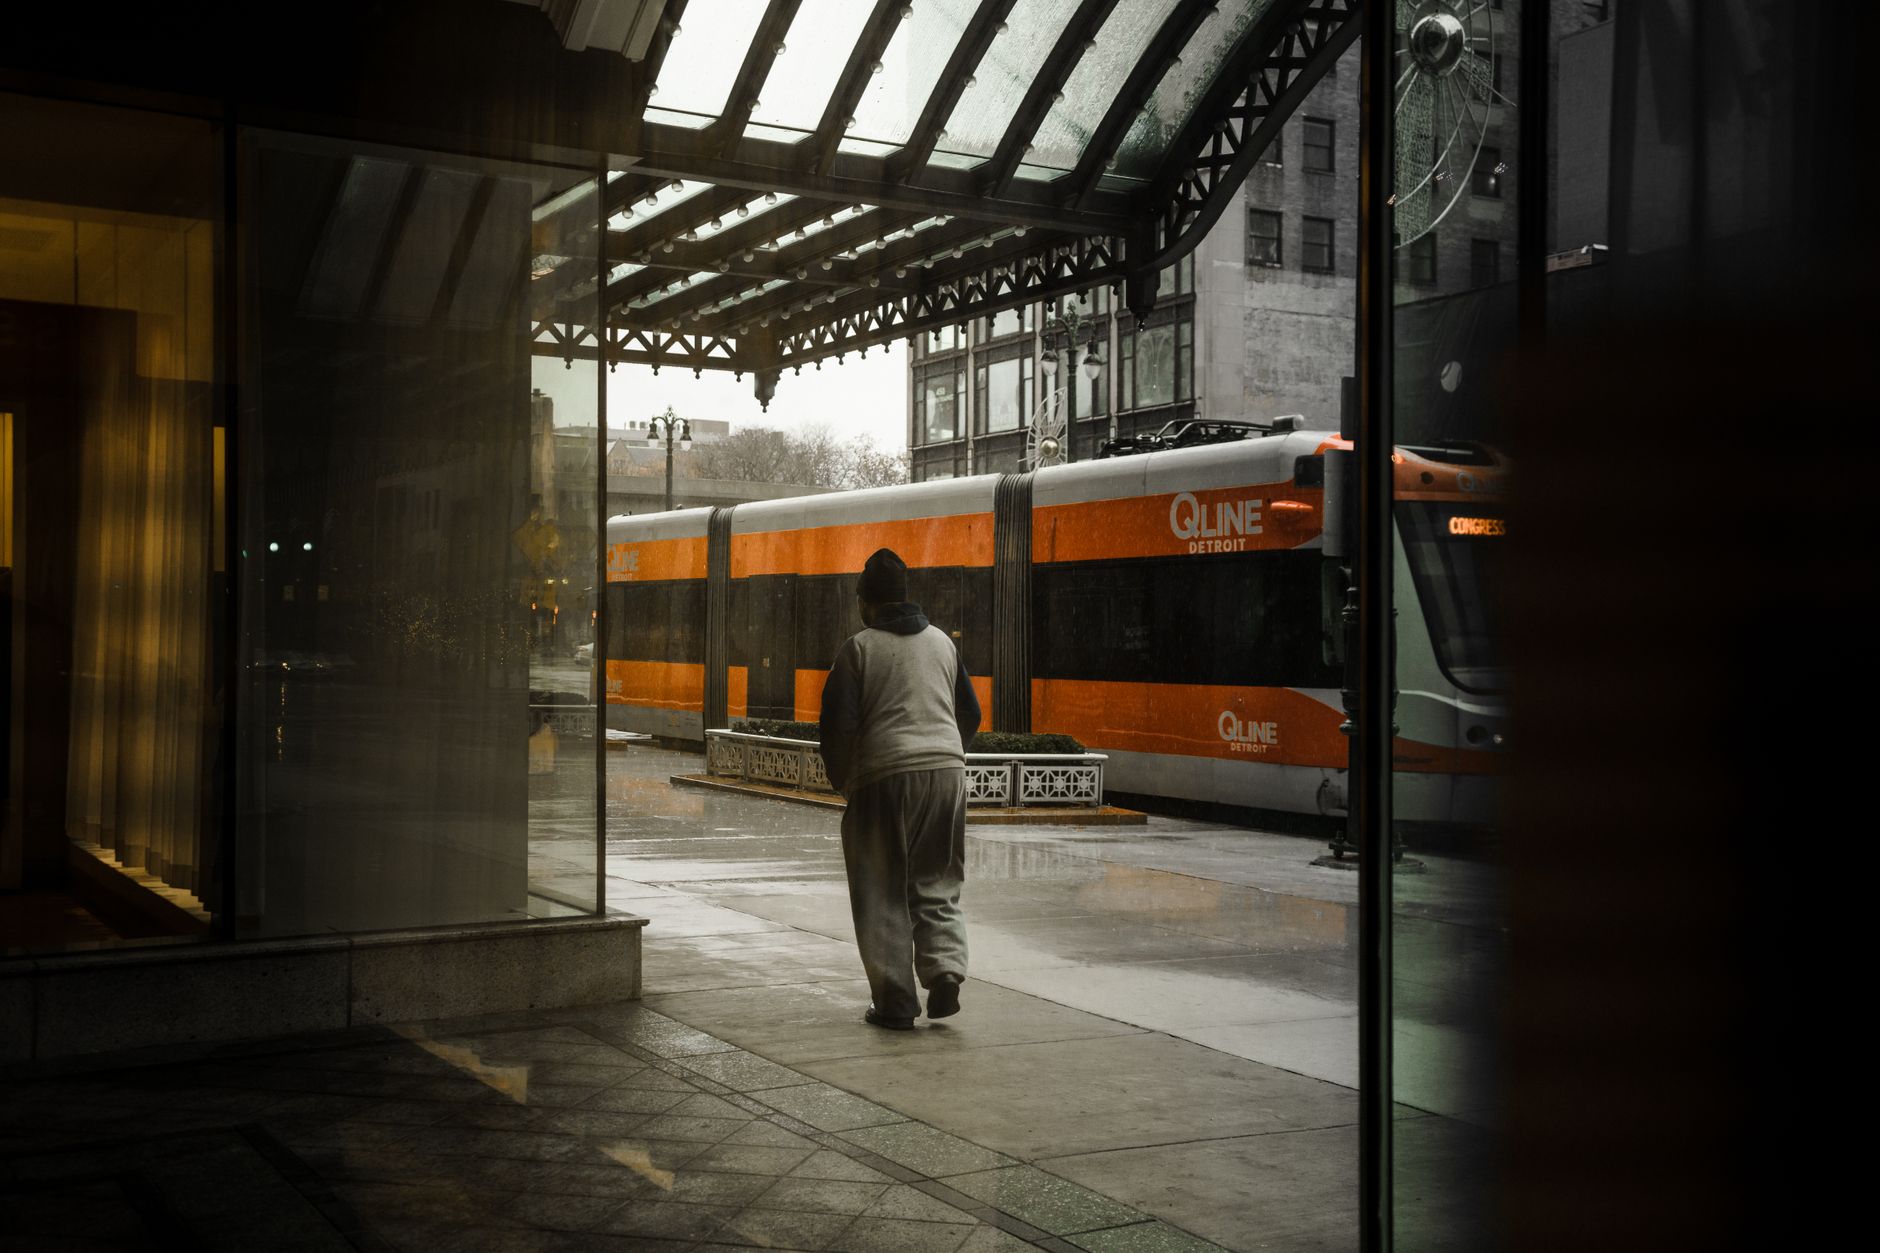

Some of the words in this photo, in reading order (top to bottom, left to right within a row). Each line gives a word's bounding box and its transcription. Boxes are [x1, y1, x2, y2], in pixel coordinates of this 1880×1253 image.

[1170, 492, 1263, 540] QLINE
[1449, 517, 1505, 535] CONGRESS
[1189, 538, 1246, 554] DETROIT
[1218, 710, 1278, 744] QLINE
[1230, 742, 1268, 753] DETROIT
